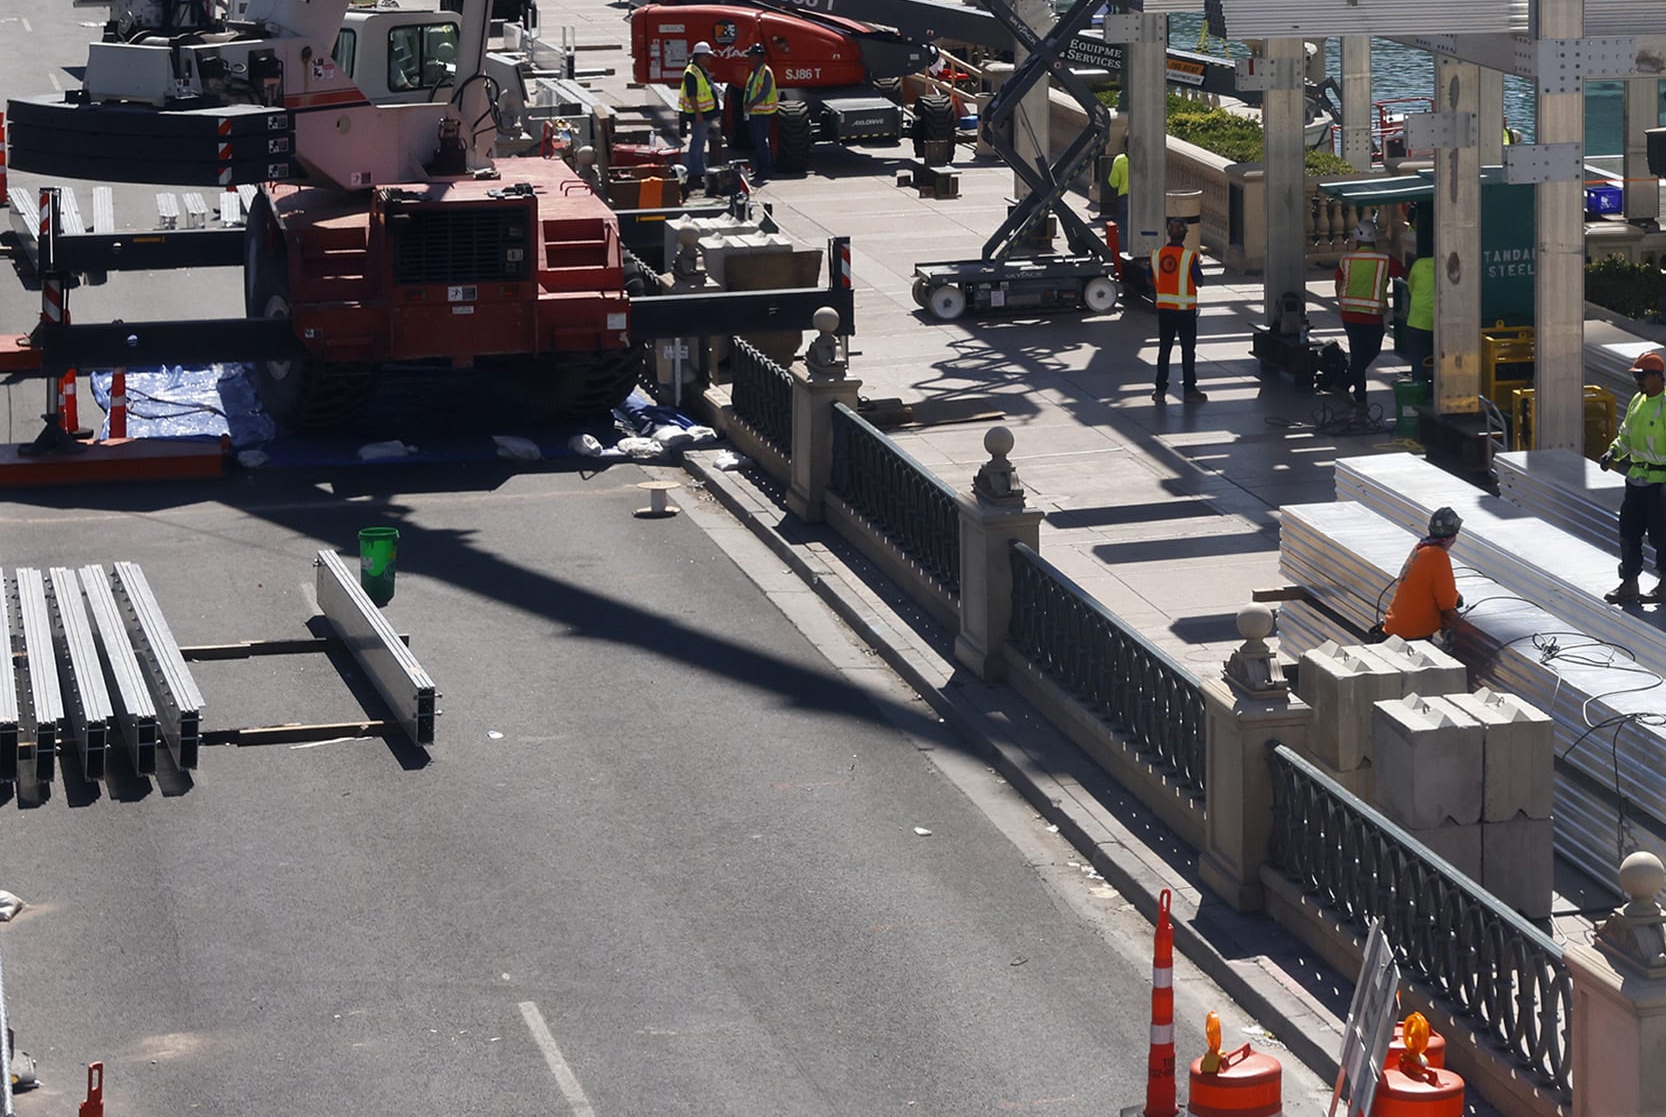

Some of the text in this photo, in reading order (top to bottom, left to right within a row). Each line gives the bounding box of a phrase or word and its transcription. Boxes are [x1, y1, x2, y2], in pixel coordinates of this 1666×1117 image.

[1067, 49, 1122, 69] SERVICES
[785, 68, 822, 80] SJ86 T
[1488, 264, 1536, 278] STEEL
